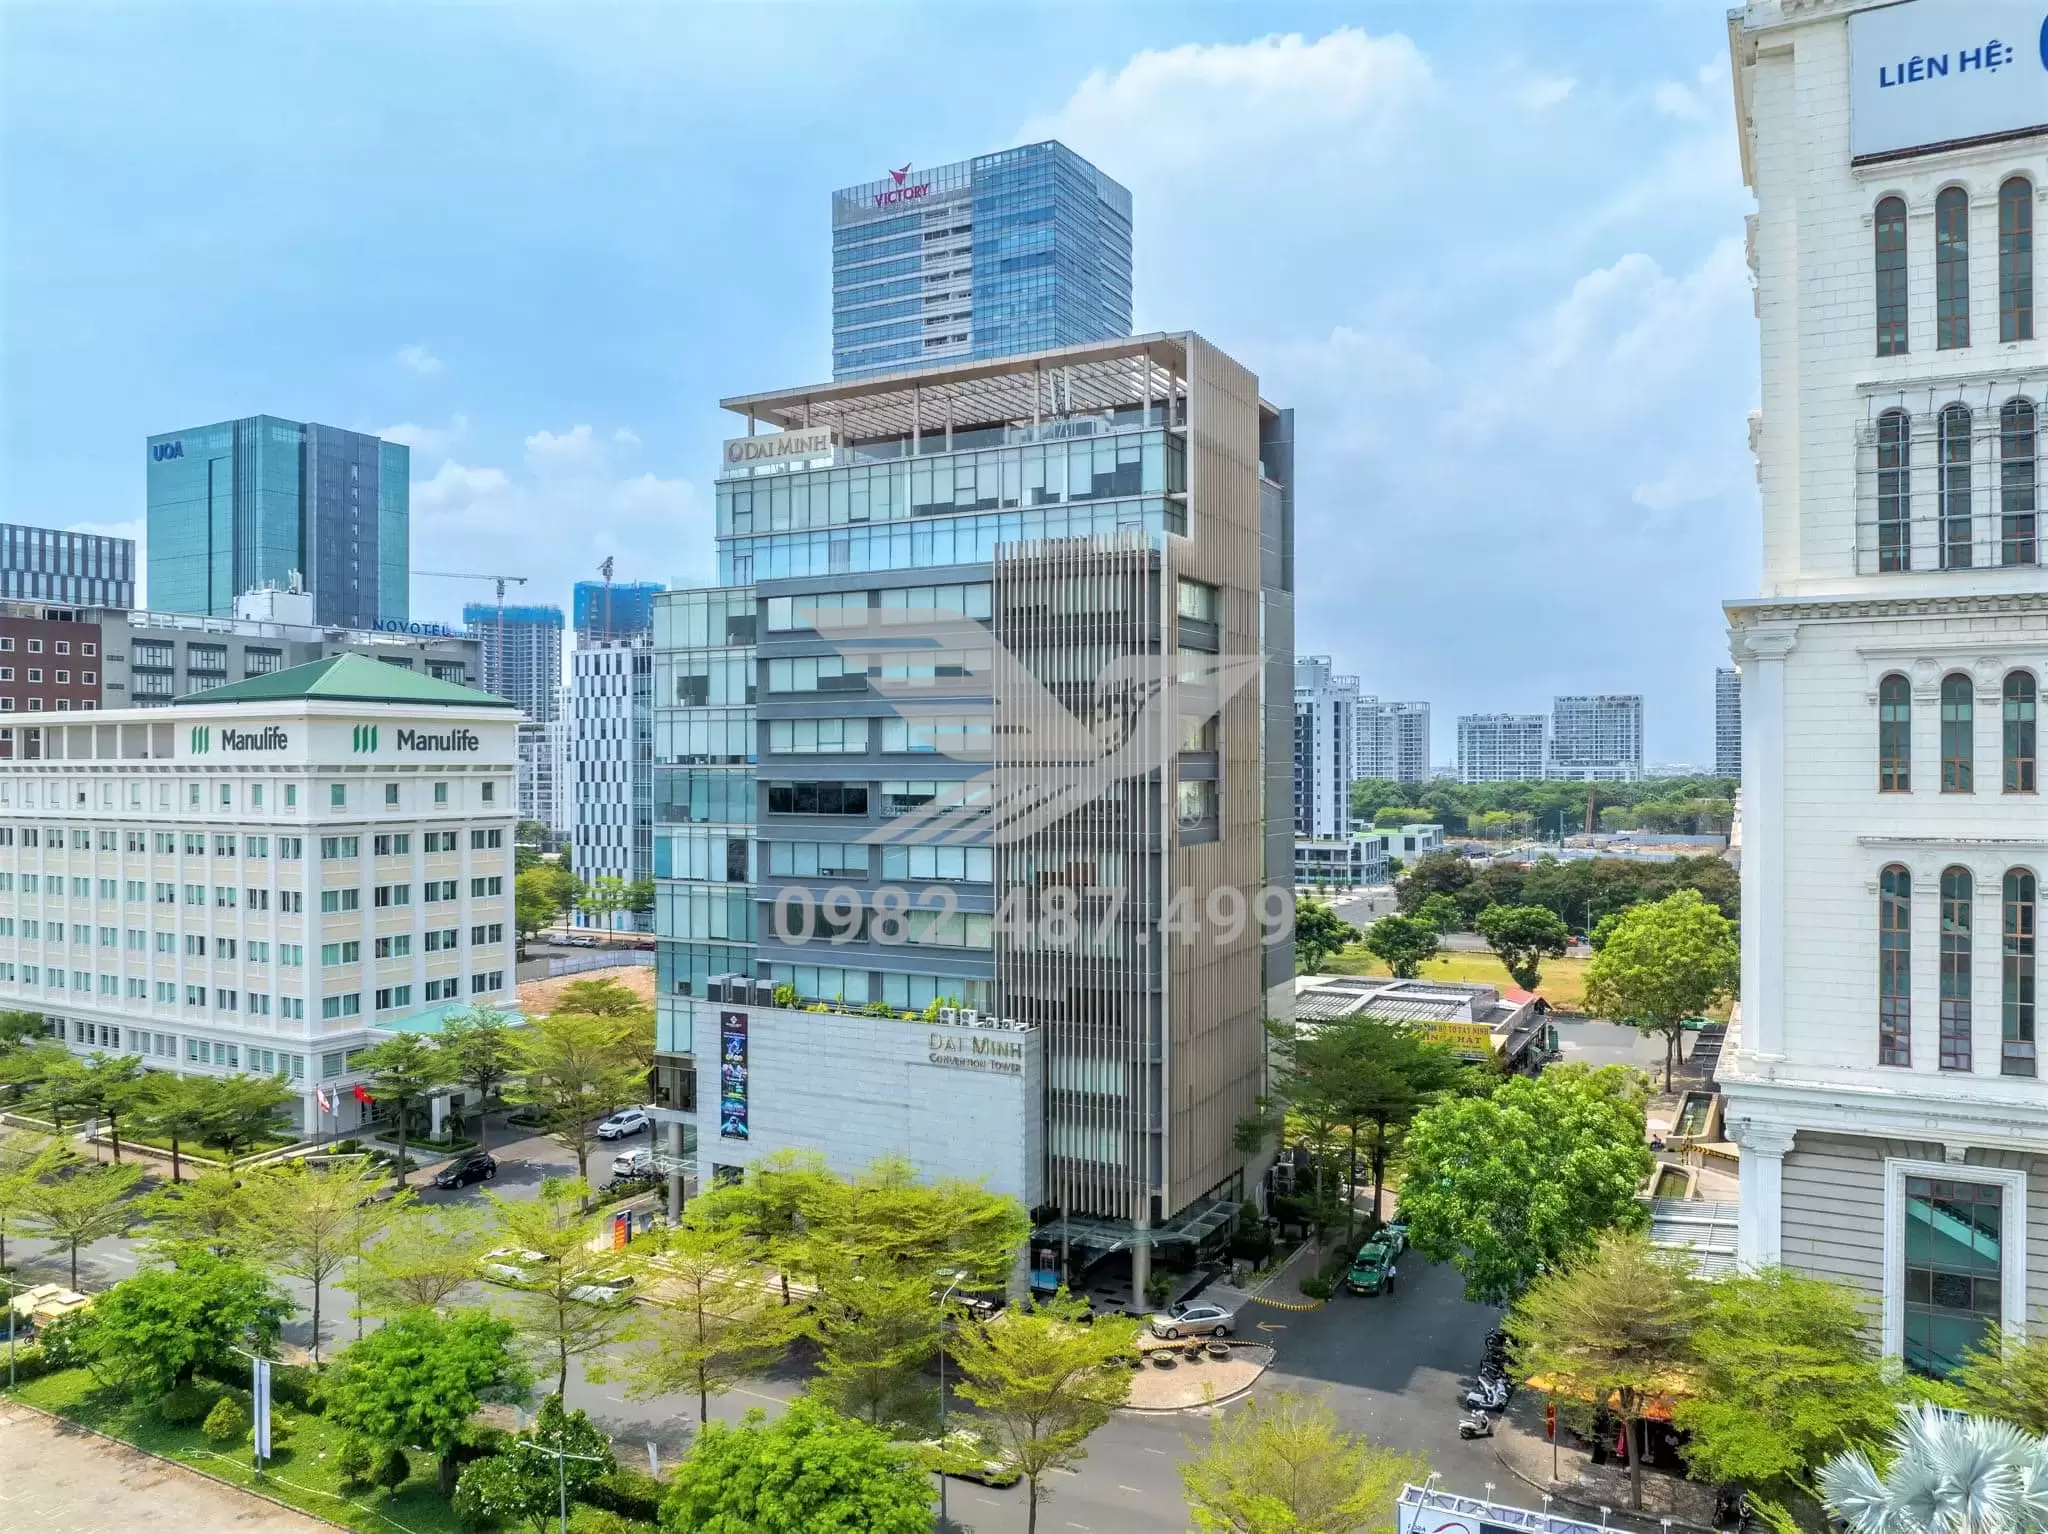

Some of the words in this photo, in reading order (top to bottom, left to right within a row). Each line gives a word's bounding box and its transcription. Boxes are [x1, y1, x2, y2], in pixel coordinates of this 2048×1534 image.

[1880, 53, 1949, 88] LIÊN
[1959, 39, 2014, 73] HỆ:
[874, 183, 930, 206] VICTORY
[152, 441, 184, 462] UOA
[777, 435, 828, 457] MINH
[372, 619, 448, 638] NOVOTEL
[221, 726, 288, 751] Manulife
[397, 728, 480, 751] Manulife
[972, 1035, 1023, 1059] MINH
